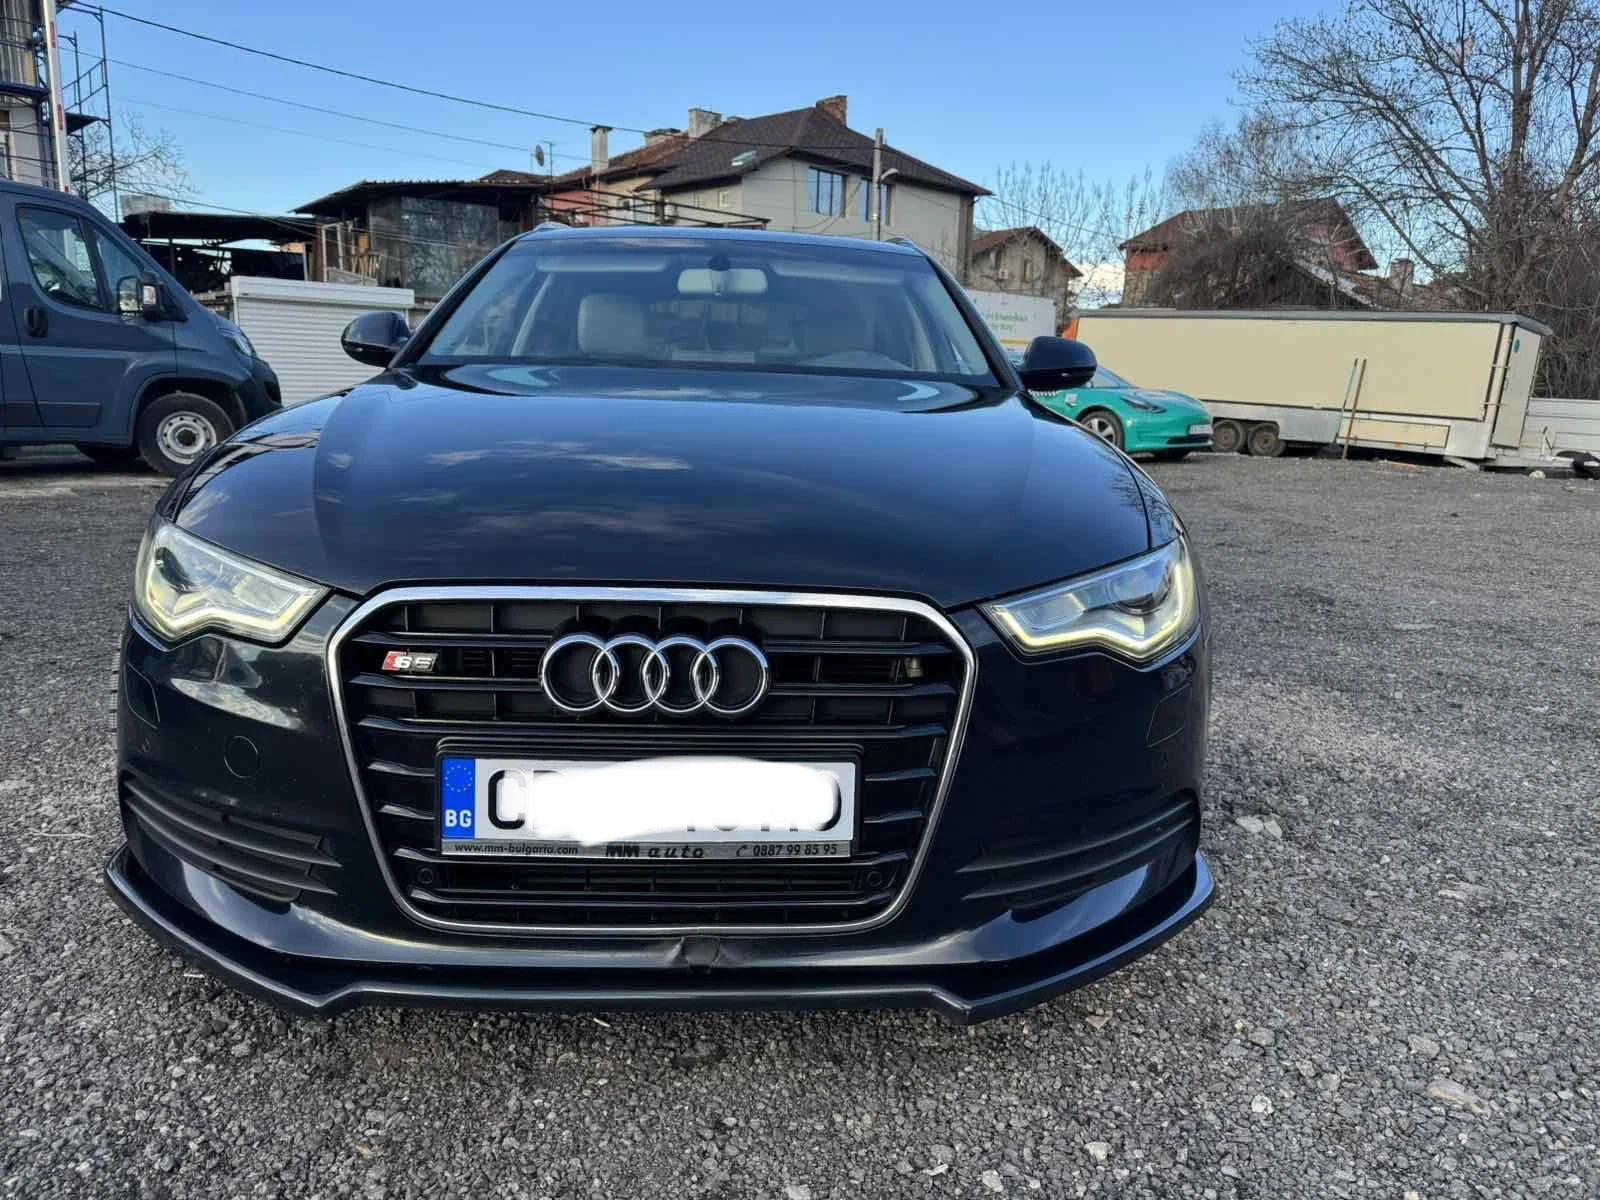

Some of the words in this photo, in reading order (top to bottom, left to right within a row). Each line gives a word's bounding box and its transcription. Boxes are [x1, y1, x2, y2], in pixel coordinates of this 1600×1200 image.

[445, 809, 472, 828] BG
[454, 842, 579, 856] www.mm-bulgaria.com
[605, 844, 640, 858] MM
[647, 844, 704, 858] auto
[753, 844, 783, 857] 0887
[786, 844, 801, 856] 99
[804, 843, 819, 855] 85
[823, 843, 838, 855] 95
